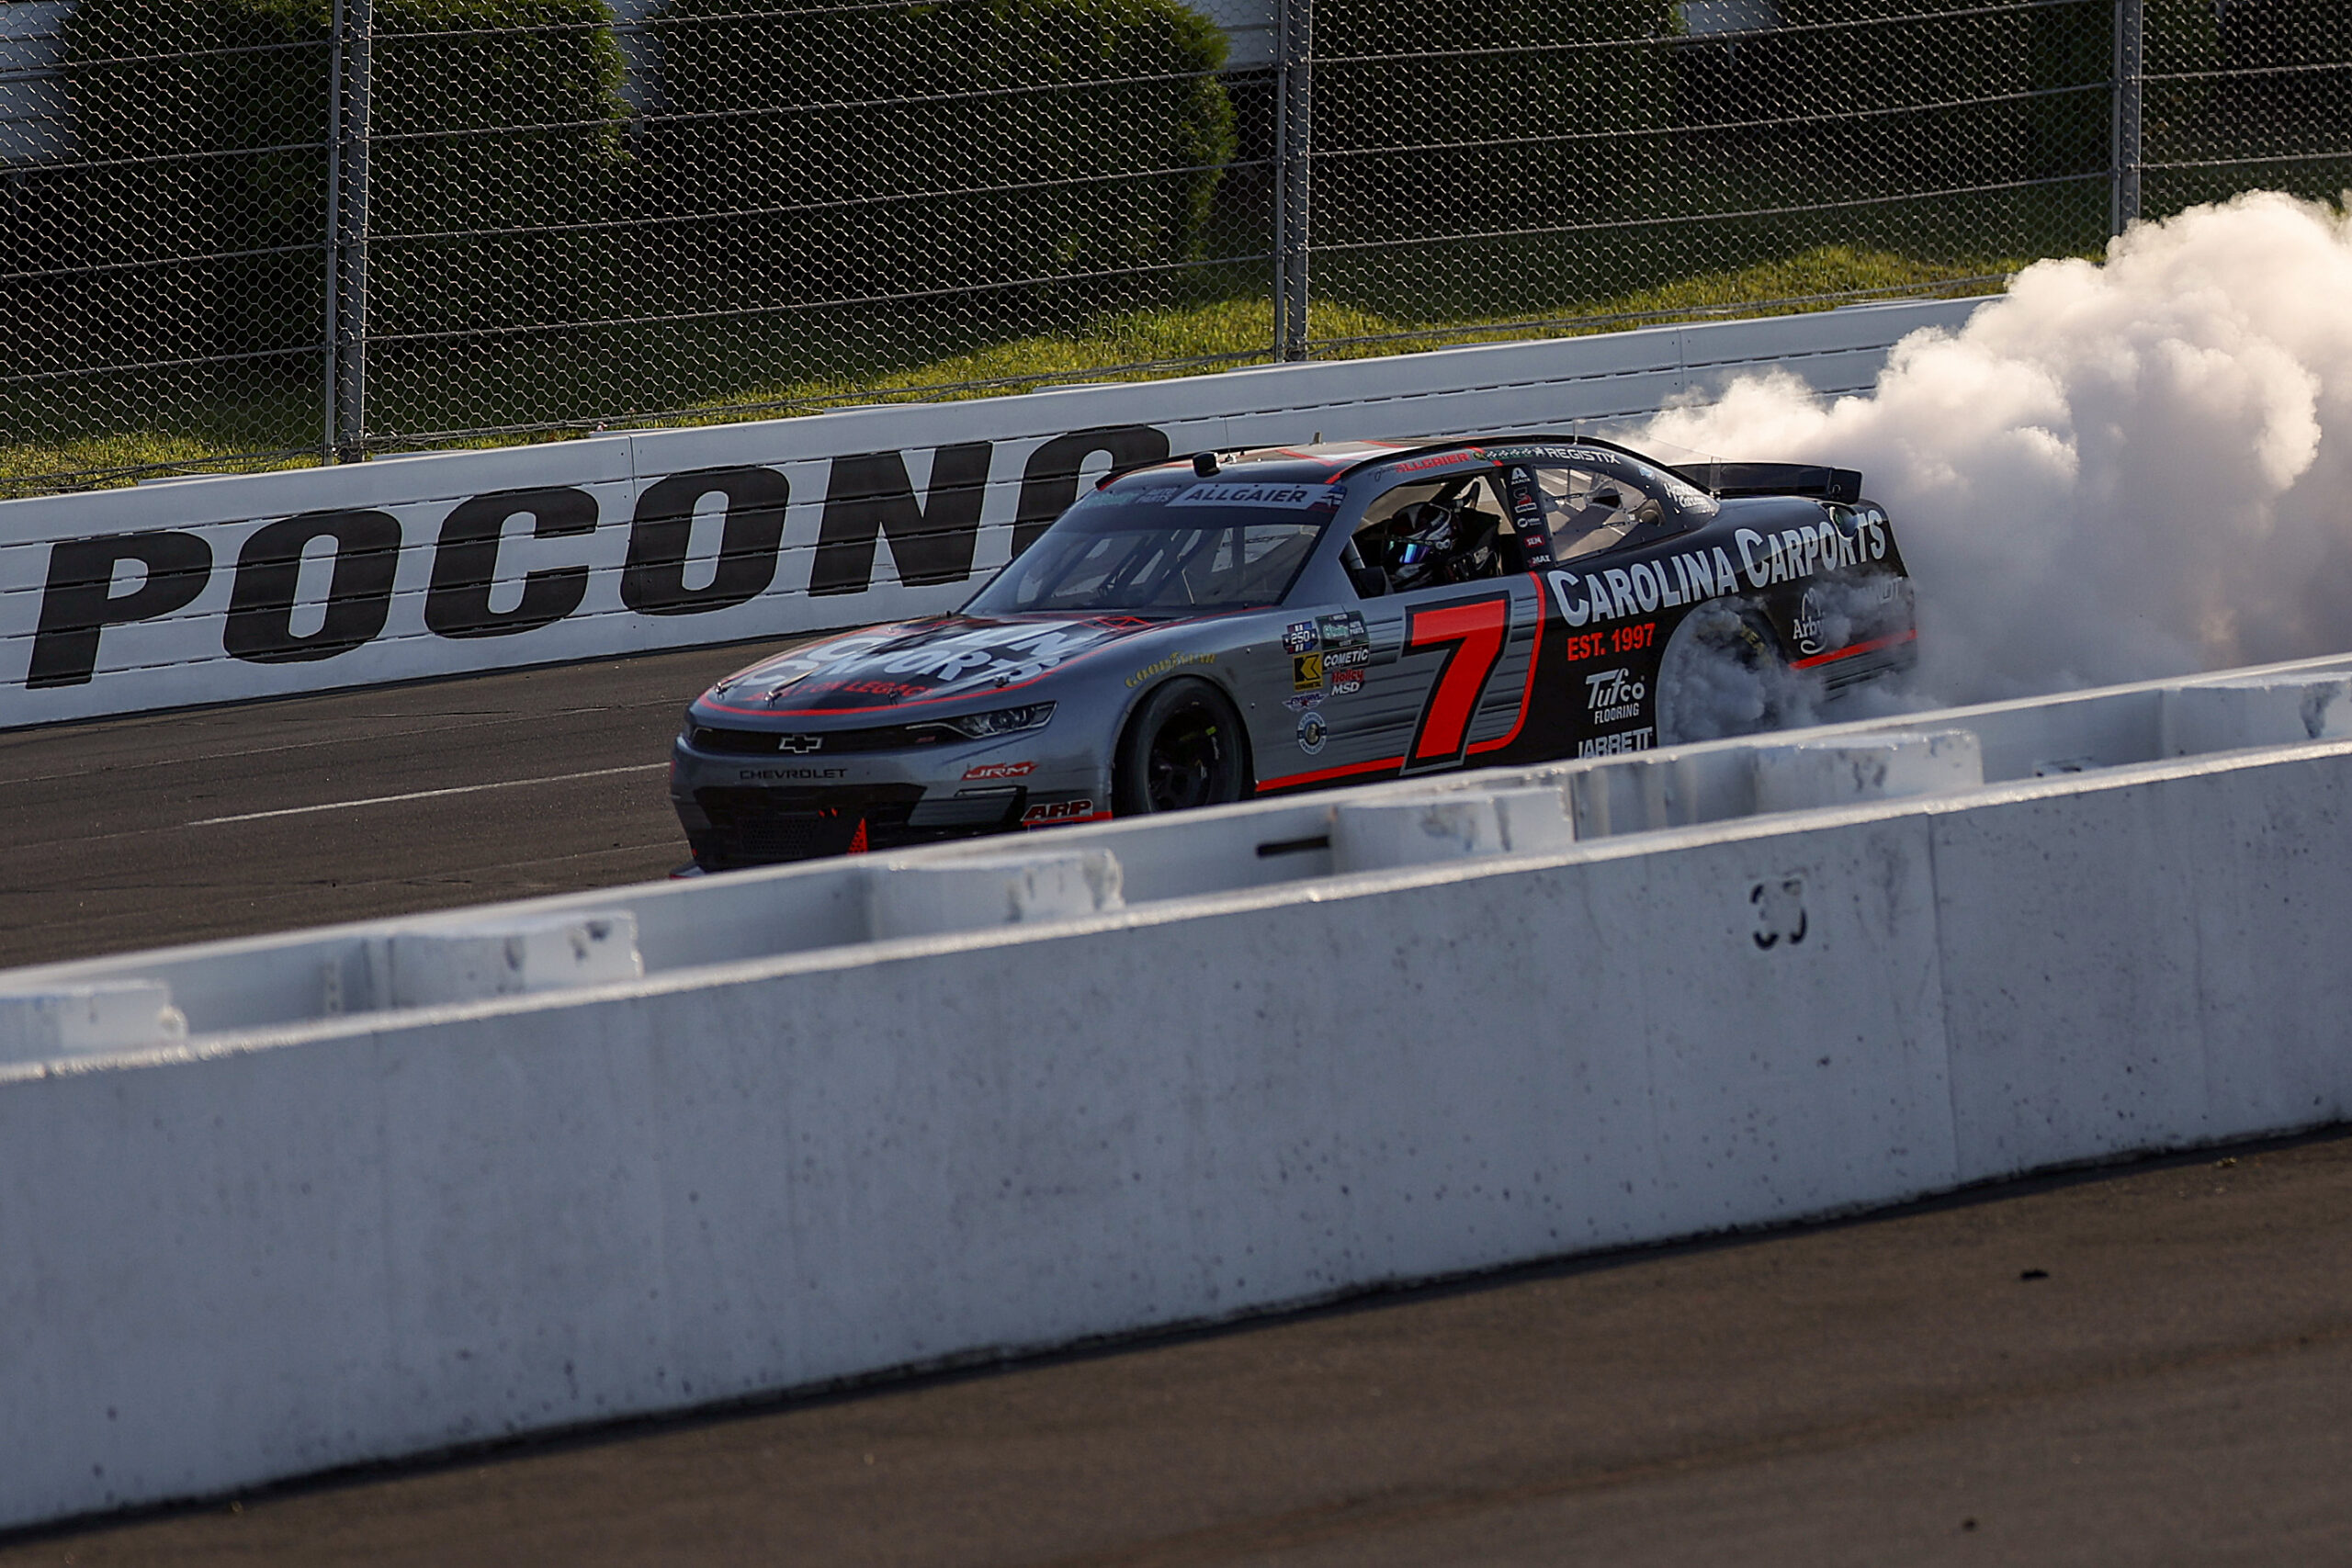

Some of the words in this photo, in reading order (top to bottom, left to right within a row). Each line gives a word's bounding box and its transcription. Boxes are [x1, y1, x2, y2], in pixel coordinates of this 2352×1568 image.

[1544, 447, 1621, 465] REGISTIX
[1185, 488, 1308, 503] ALLGAIER
[26, 425, 1170, 689] POCONO
[1735, 509, 1886, 589] CARPORTS
[1547, 547, 1740, 626] CAROLINA
[1291, 630, 1310, 645] 250
[1792, 614, 1832, 640] Arby
[1566, 631, 1606, 661] EST.
[1611, 622, 1656, 652] 1997
[1323, 648, 1369, 668] COMETIC
[1330, 682, 1360, 696] MSD
[1409, 598, 1507, 761] 7
[1585, 668, 1645, 709] Tufco
[1594, 703, 1640, 725] FLOORING
[740, 768, 847, 780] CHEVROLET
[967, 764, 1030, 778] JRM
[1021, 798, 1093, 821] ARP
